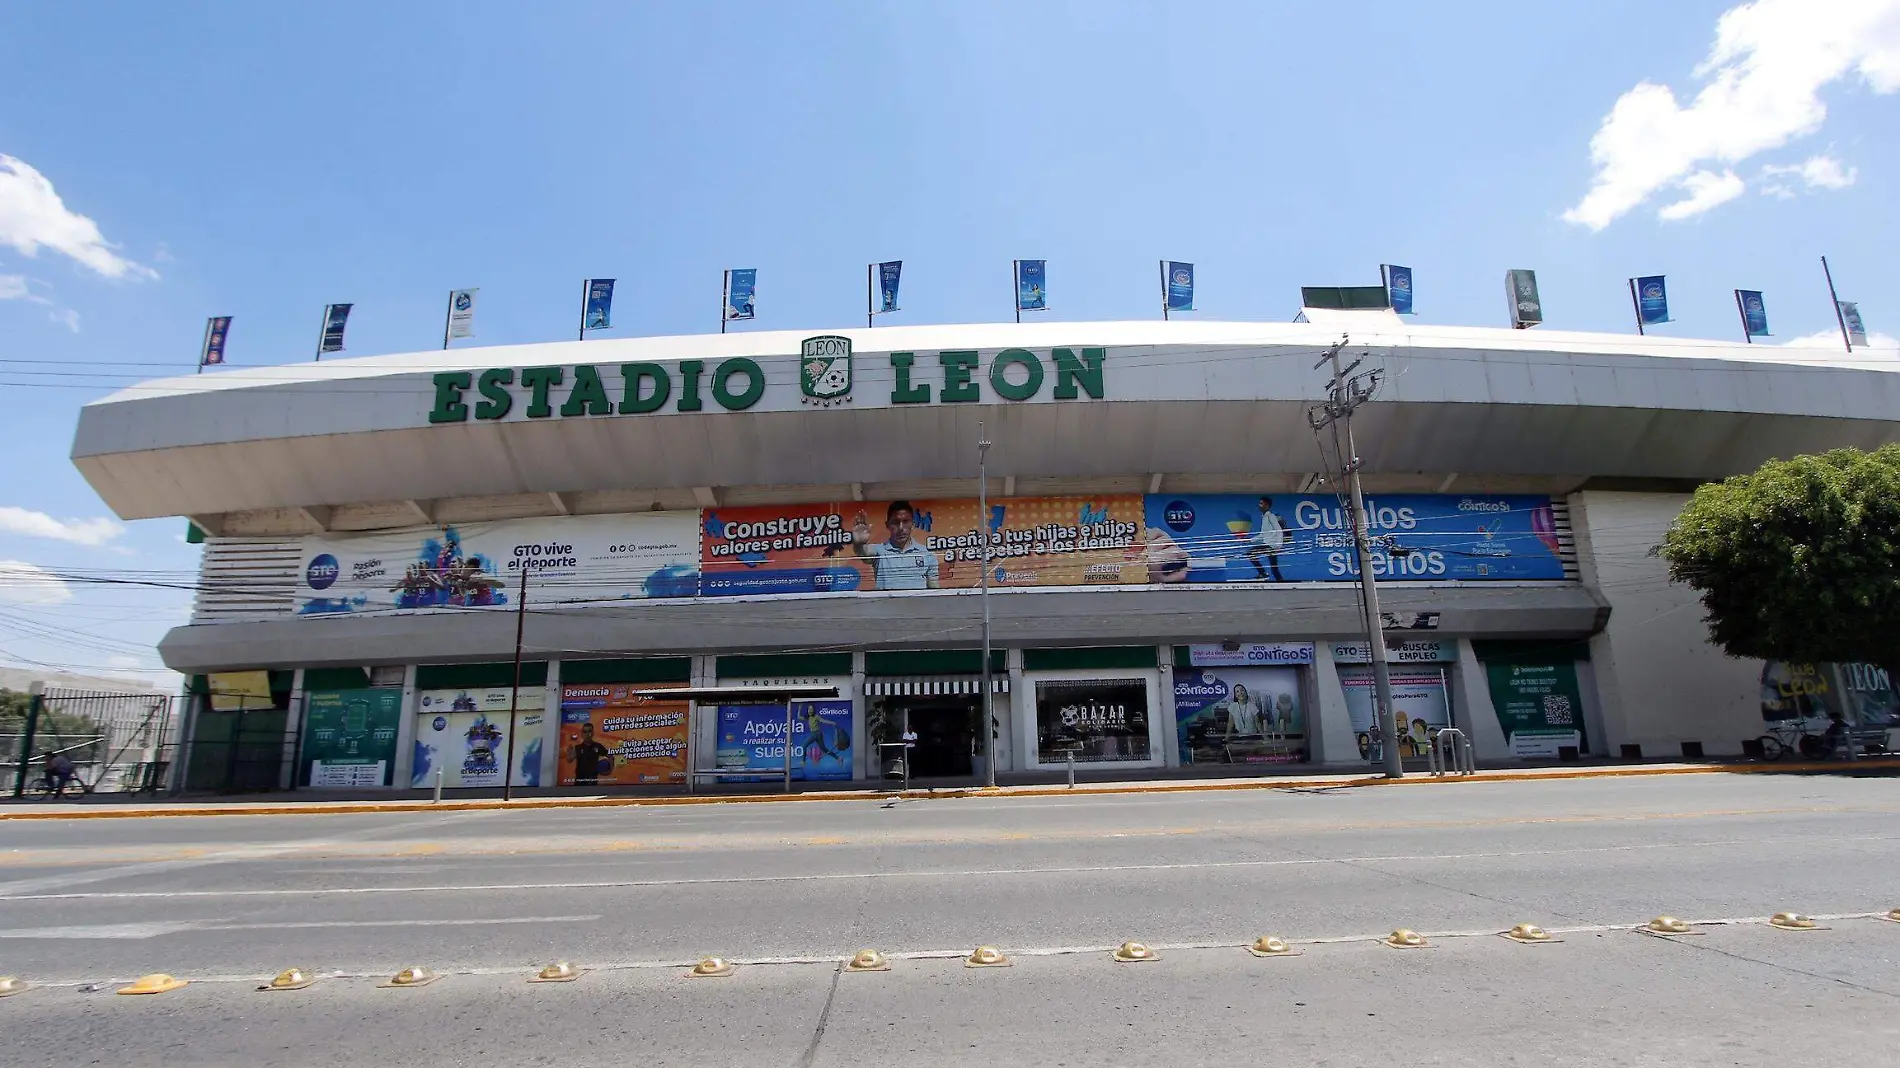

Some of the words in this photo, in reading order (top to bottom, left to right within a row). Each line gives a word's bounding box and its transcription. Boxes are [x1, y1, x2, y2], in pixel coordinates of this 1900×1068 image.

[806, 339, 847, 356] LEON
[429, 357, 766, 424] ESTADIO
[890, 348, 1106, 404] LEON
[1168, 510, 1193, 520] GTO
[723, 514, 840, 539] Construye
[992, 533, 1002, 544] a
[1005, 529, 1033, 543] tus
[1037, 525, 1077, 543] hijas
[1080, 525, 1090, 536] e
[1094, 519, 1136, 537] hijos
[513, 544, 542, 557] GTO
[544, 541, 573, 554] vive
[711, 540, 770, 556] valores
[773, 538, 793, 550] en
[796, 530, 852, 548] familia
[944, 550, 955, 562] a
[958, 543, 1030, 562] respetar
[1036, 543, 1045, 554] a
[1049, 539, 1075, 552] los
[507, 558, 520, 571] el
[522, 556, 577, 572] deporte
[1335, 646, 1358, 656] GTO
[1402, 642, 1440, 651] BUSCAS
[1398, 651, 1438, 661] EMPLEO
[743, 678, 830, 687] TAQUILLAS
[565, 688, 610, 698] Denuncia
[1174, 685, 1215, 695] CONTIGO
[626, 717, 636, 725] tu
[637, 711, 684, 722] información
[1081, 704, 1125, 721] BAZAR
[621, 721, 643, 730] redes
[644, 720, 677, 728] sociales
[744, 718, 804, 738] Apóyala
[623, 739, 642, 748] Evita
[643, 738, 672, 748] aceptar
[749, 737, 776, 745] realizar
[608, 744, 654, 755] invitaciones
[665, 743, 687, 752] algún
[624, 750, 671, 759] desconocido
